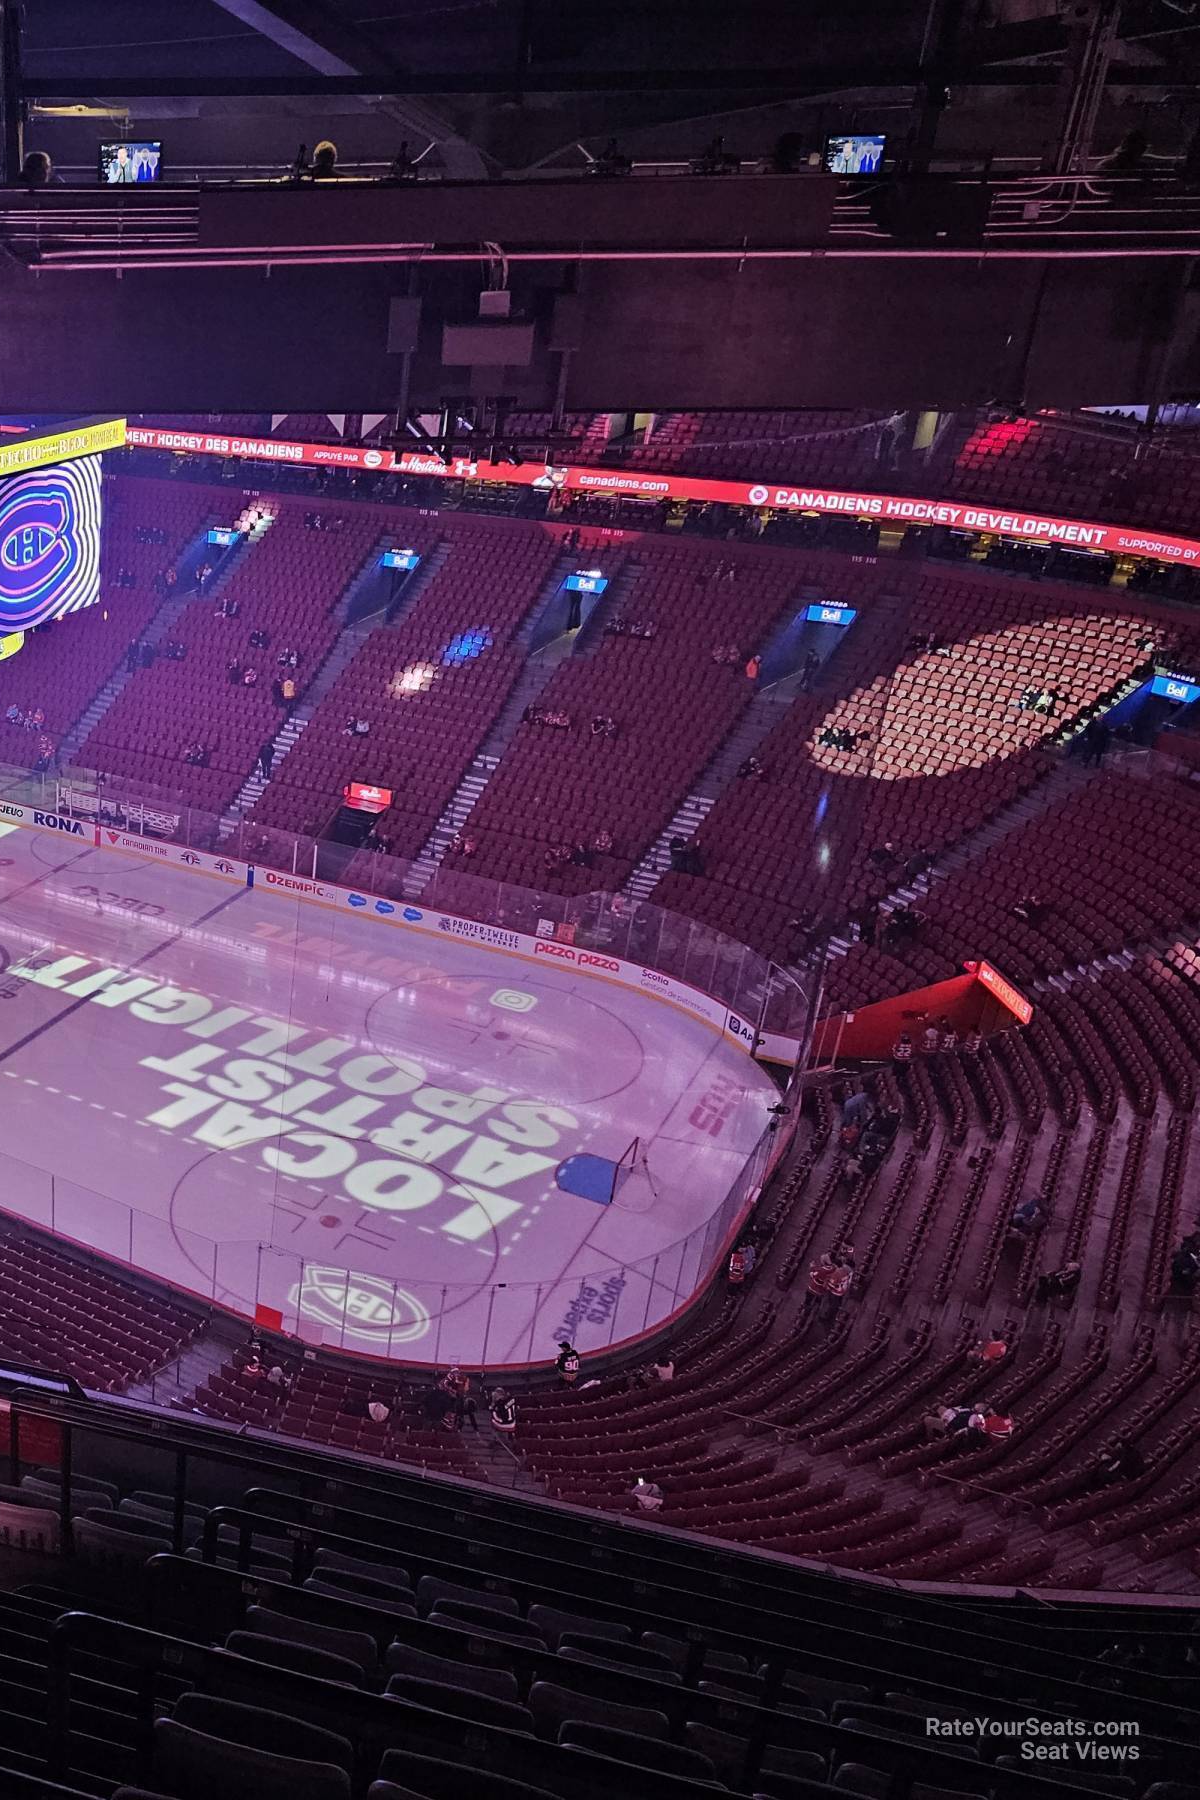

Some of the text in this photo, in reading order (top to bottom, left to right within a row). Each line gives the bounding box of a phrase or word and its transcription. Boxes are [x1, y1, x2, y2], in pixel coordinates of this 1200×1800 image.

[157, 432, 202, 449] HOCKEY
[205, 436, 230, 452] DES
[231, 439, 304, 460] CANADIENS
[343, 453, 359, 463] PAR
[579, 474, 669, 492] canadiens.com
[774, 490, 1199, 560] CANADIENS HOCKEY DEVELOPMENT SUPPORTED BY
[578, 579, 596, 590] Bell
[821, 609, 841, 621] Bell
[1166, 683, 1188, 698] Bell
[34, 811, 85, 836] RONA
[122, 838, 168, 857] CANADIAN TIRE
[534, 941, 620, 973] pizza pizza
[641, 969, 669, 986] Scotia
[5, 955, 579, 1149] SPOTLIGHT
[138, 1043, 562, 1189] ARTIST
[144, 1082, 526, 1242] LOCAL
[592, 1275, 628, 1327] sports
[564, 1359, 579, 1371] 90
